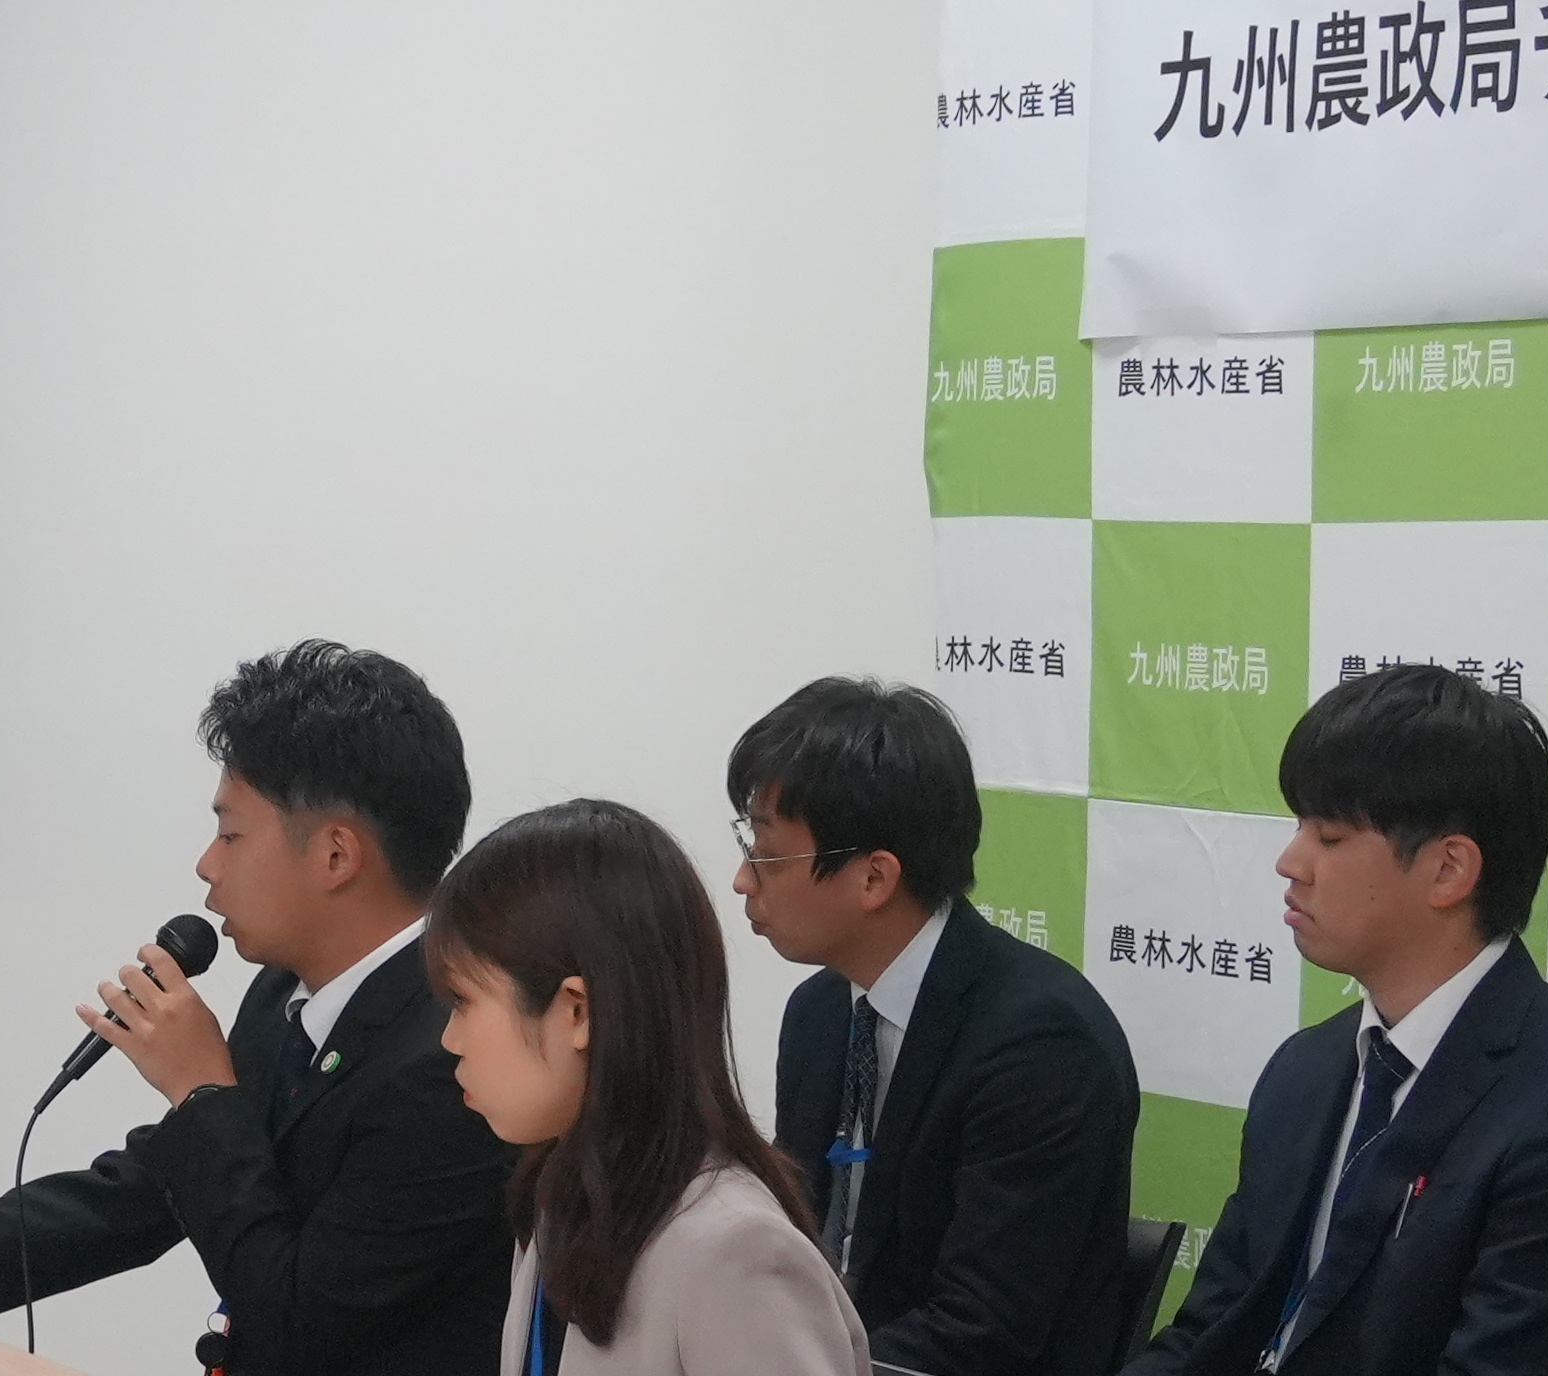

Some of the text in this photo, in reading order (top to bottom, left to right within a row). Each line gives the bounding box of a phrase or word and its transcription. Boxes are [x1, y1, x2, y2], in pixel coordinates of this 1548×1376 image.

[931, 355, 1058, 403] 九州農政局
[1117, 354, 1285, 398] 農林水産省
[1354, 337, 1516, 394] 九州農政局
[935, 634, 1066, 679] 林水産省
[1127, 640, 1269, 697] 九州農政局
[1109, 923, 1274, 985] 農林水産省
